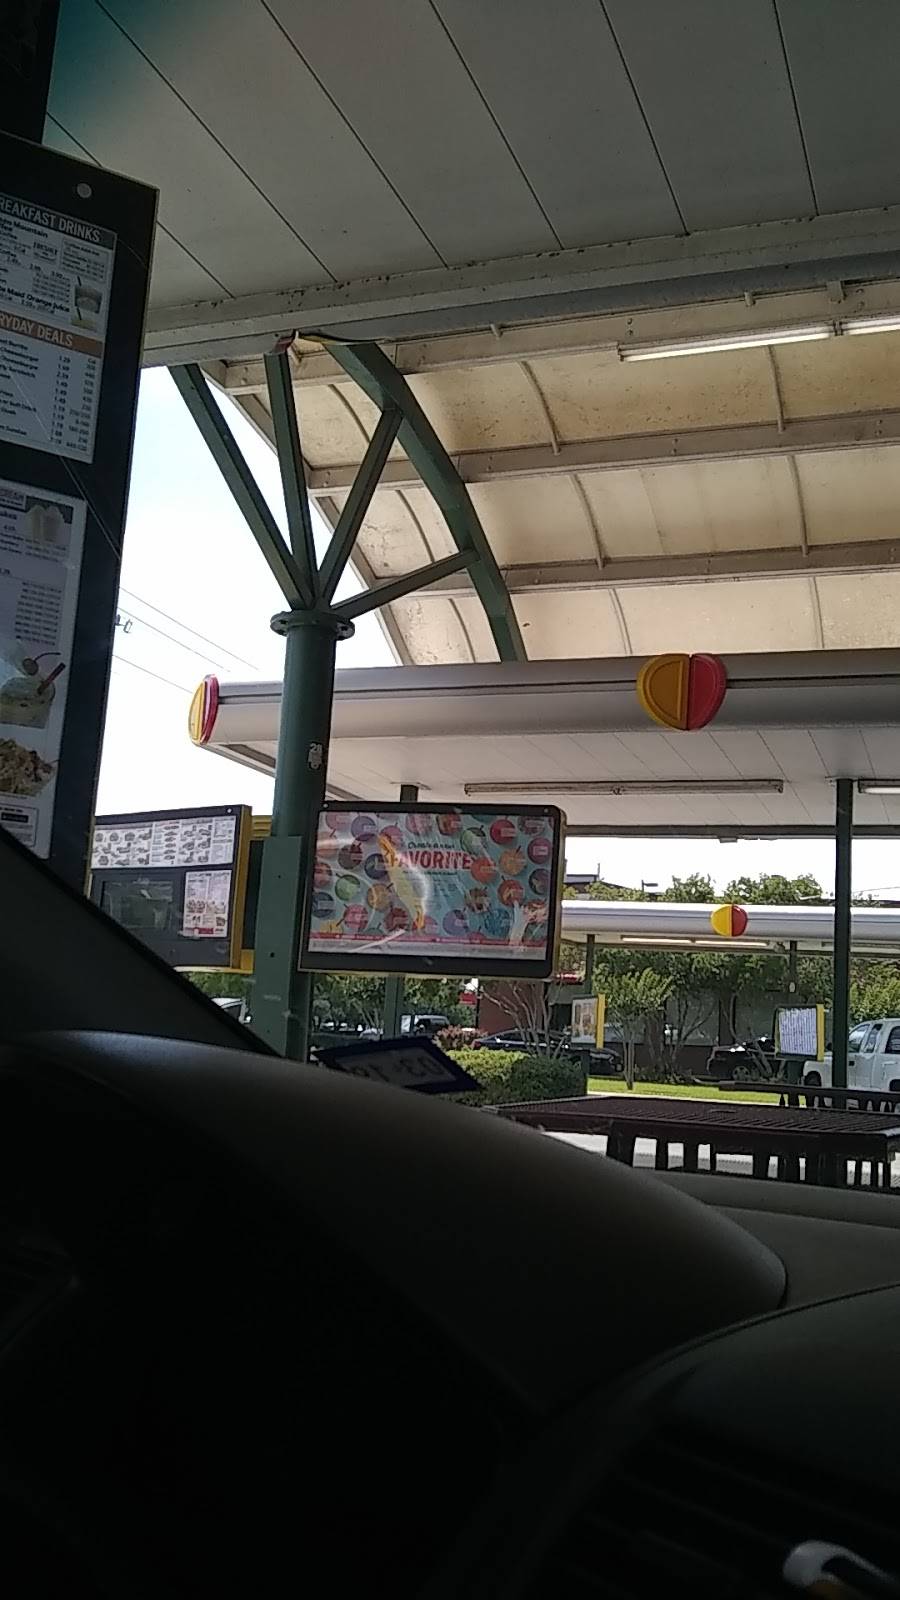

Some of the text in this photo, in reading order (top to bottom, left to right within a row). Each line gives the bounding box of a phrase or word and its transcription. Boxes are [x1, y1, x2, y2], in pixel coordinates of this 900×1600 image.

[59, 218, 102, 243] DRINKS
[26, 294, 52, 307] Orange
[36, 324, 73, 347] DEALS
